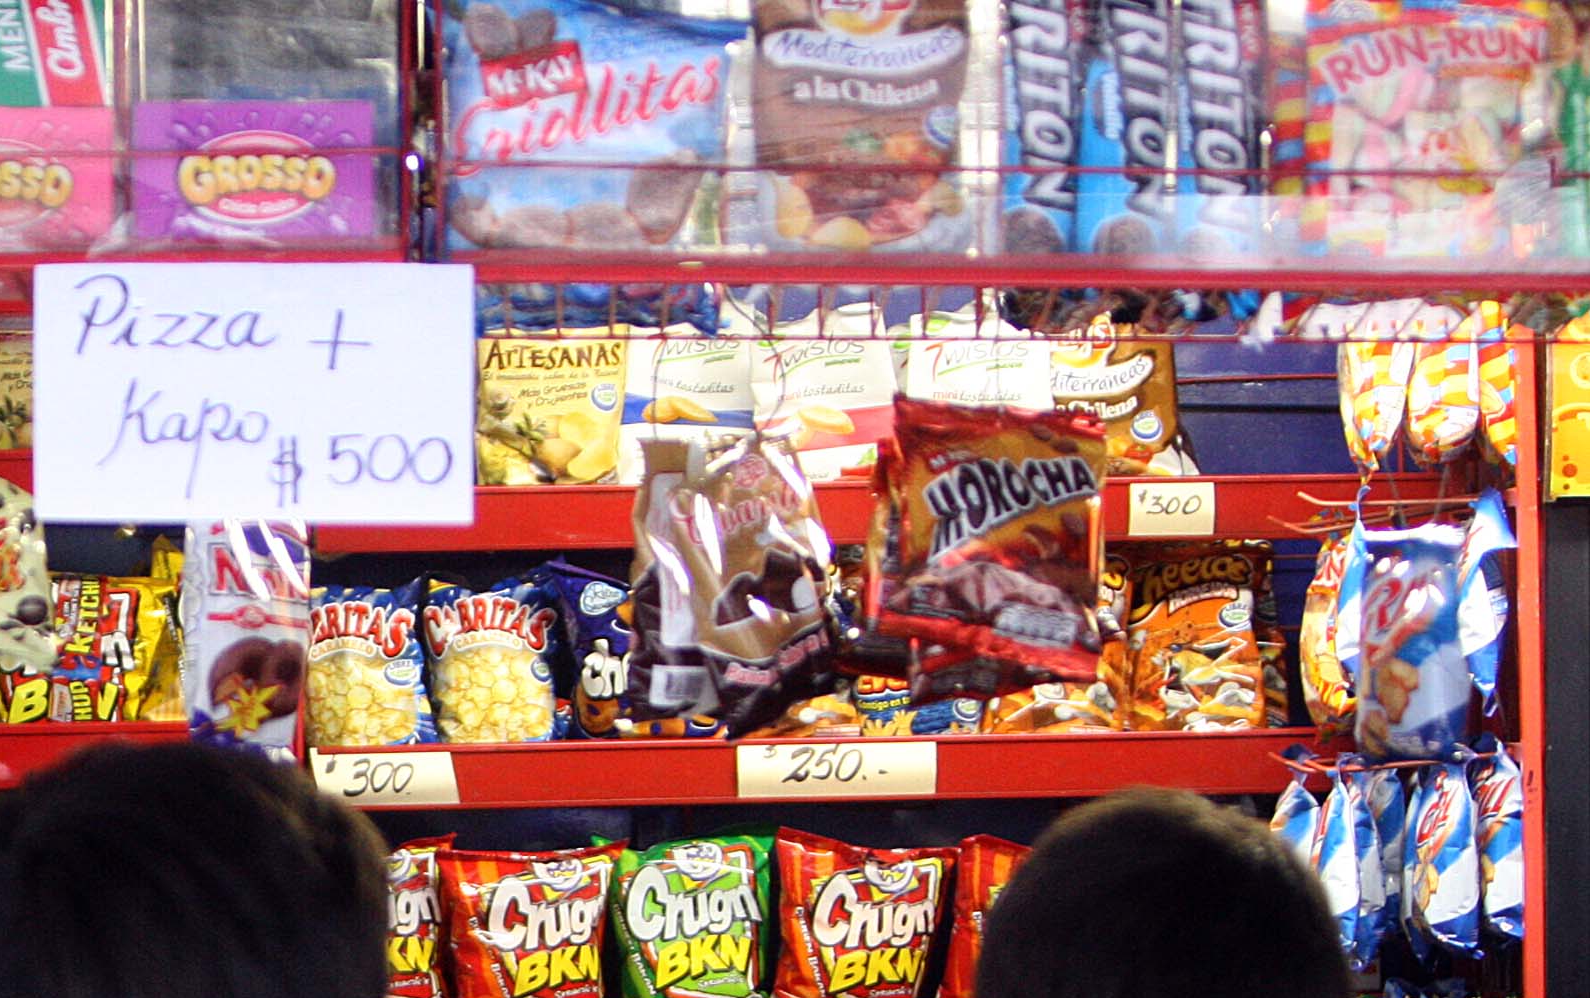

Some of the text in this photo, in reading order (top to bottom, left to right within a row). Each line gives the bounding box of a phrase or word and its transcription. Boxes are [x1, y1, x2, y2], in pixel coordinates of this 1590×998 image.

[1325, 26, 1543, 93] RUN-RUN
[456, 56, 721, 177] Criollitas
[1009, 0, 1076, 212] RITON
[1110, 0, 1178, 214] RITON
[178, 154, 337, 205] GROSSO
[74, 272, 278, 356] Pizza
[1051, 356, 1150, 391] diterraneas
[96, 377, 270, 499] Kapo
[1137, 488, 1203, 516] $300
[324, 753, 416, 798] $300
[513, 943, 601, 998] BKN
[655, 933, 754, 991] BKN
[828, 945, 927, 994] BKN
